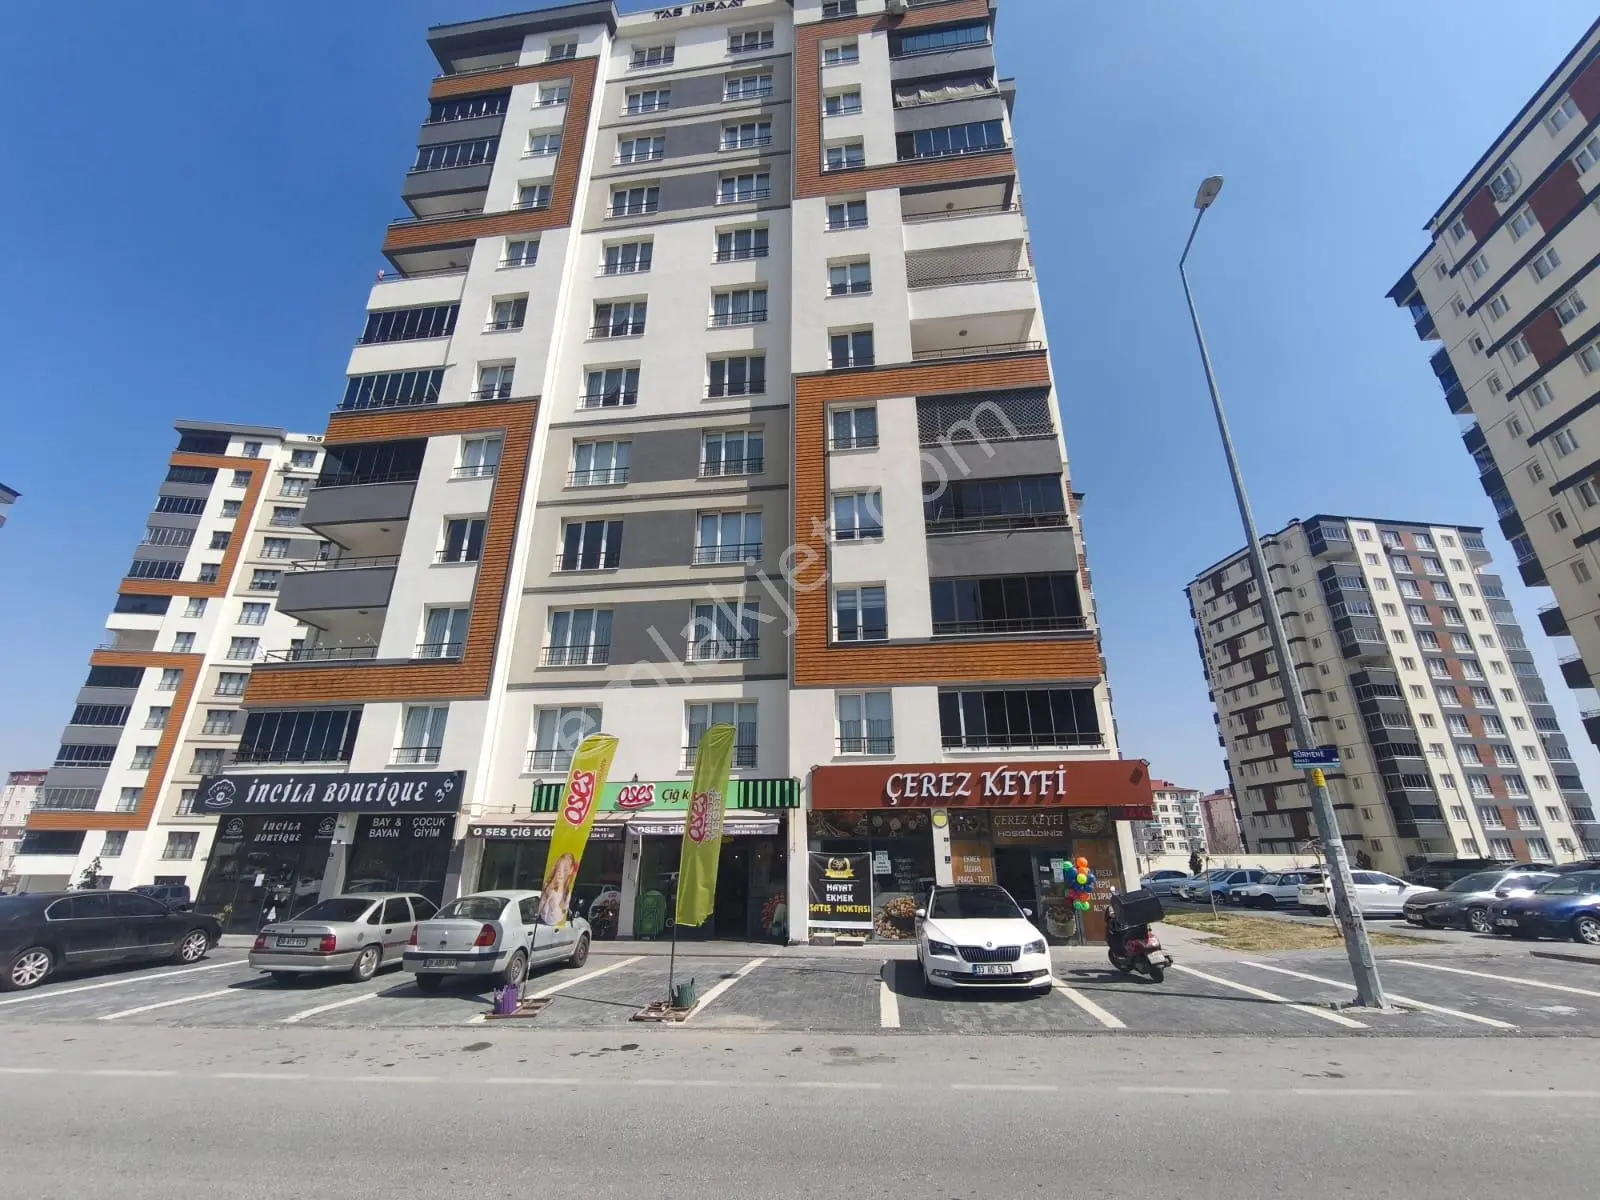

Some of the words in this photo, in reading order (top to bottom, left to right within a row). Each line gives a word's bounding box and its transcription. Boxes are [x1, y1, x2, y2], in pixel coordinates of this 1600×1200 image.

[885, 772, 972, 805] ÇEREZ
[981, 764, 1067, 797] KEYFİ
[372, 818, 392, 827] BAY
[394, 818, 401, 826] &
[412, 817, 446, 827] ÇOCUK
[368, 828, 400, 838] BAYAN
[413, 826, 440, 837] GİYİM
[485, 827, 507, 837] SES
[510, 826, 531, 838] ÇİĞ
[826, 883, 853, 892] HAYAT
[826, 894, 854, 902] EKMEK
[809, 903, 832, 914] SATIŞ
